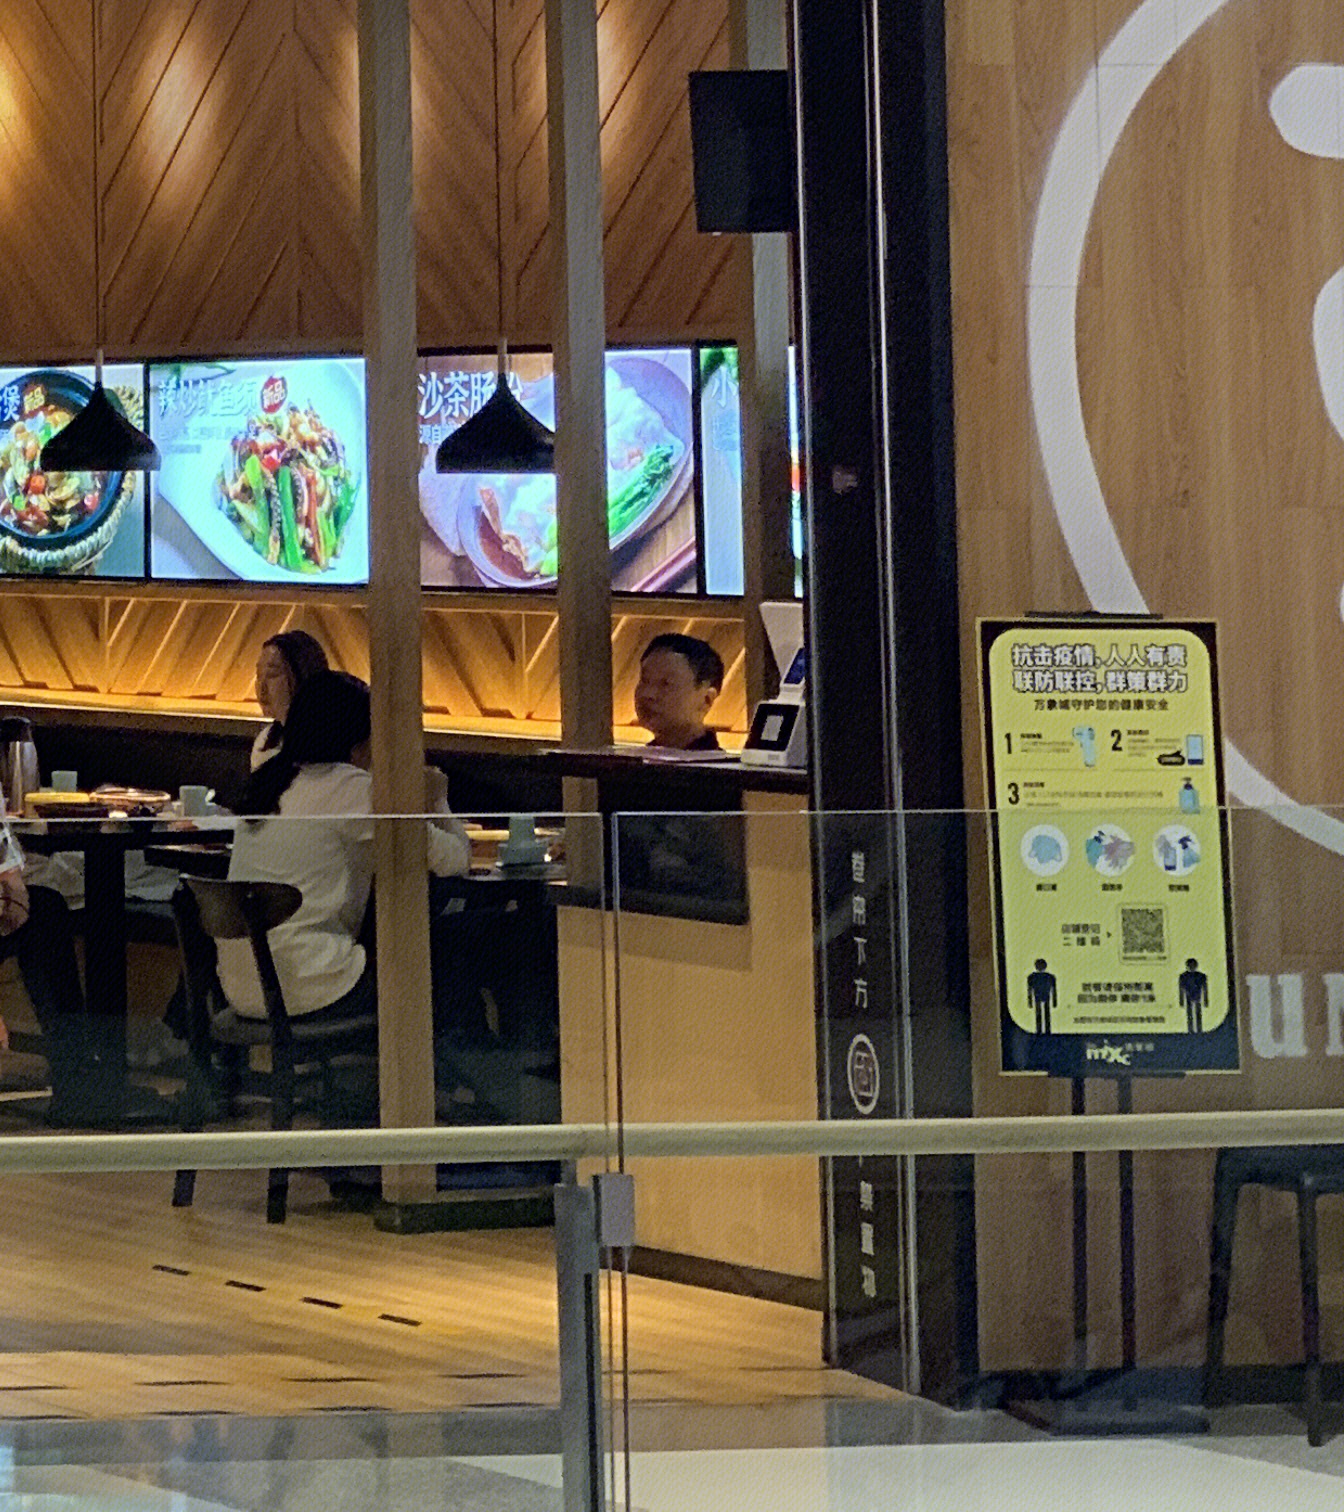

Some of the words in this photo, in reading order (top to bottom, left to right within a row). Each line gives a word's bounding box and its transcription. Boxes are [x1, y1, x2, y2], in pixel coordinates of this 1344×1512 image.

[1004, 732, 1012, 754] 1
[1111, 729, 1123, 752] 2
[1007, 782, 1020, 805] 3
